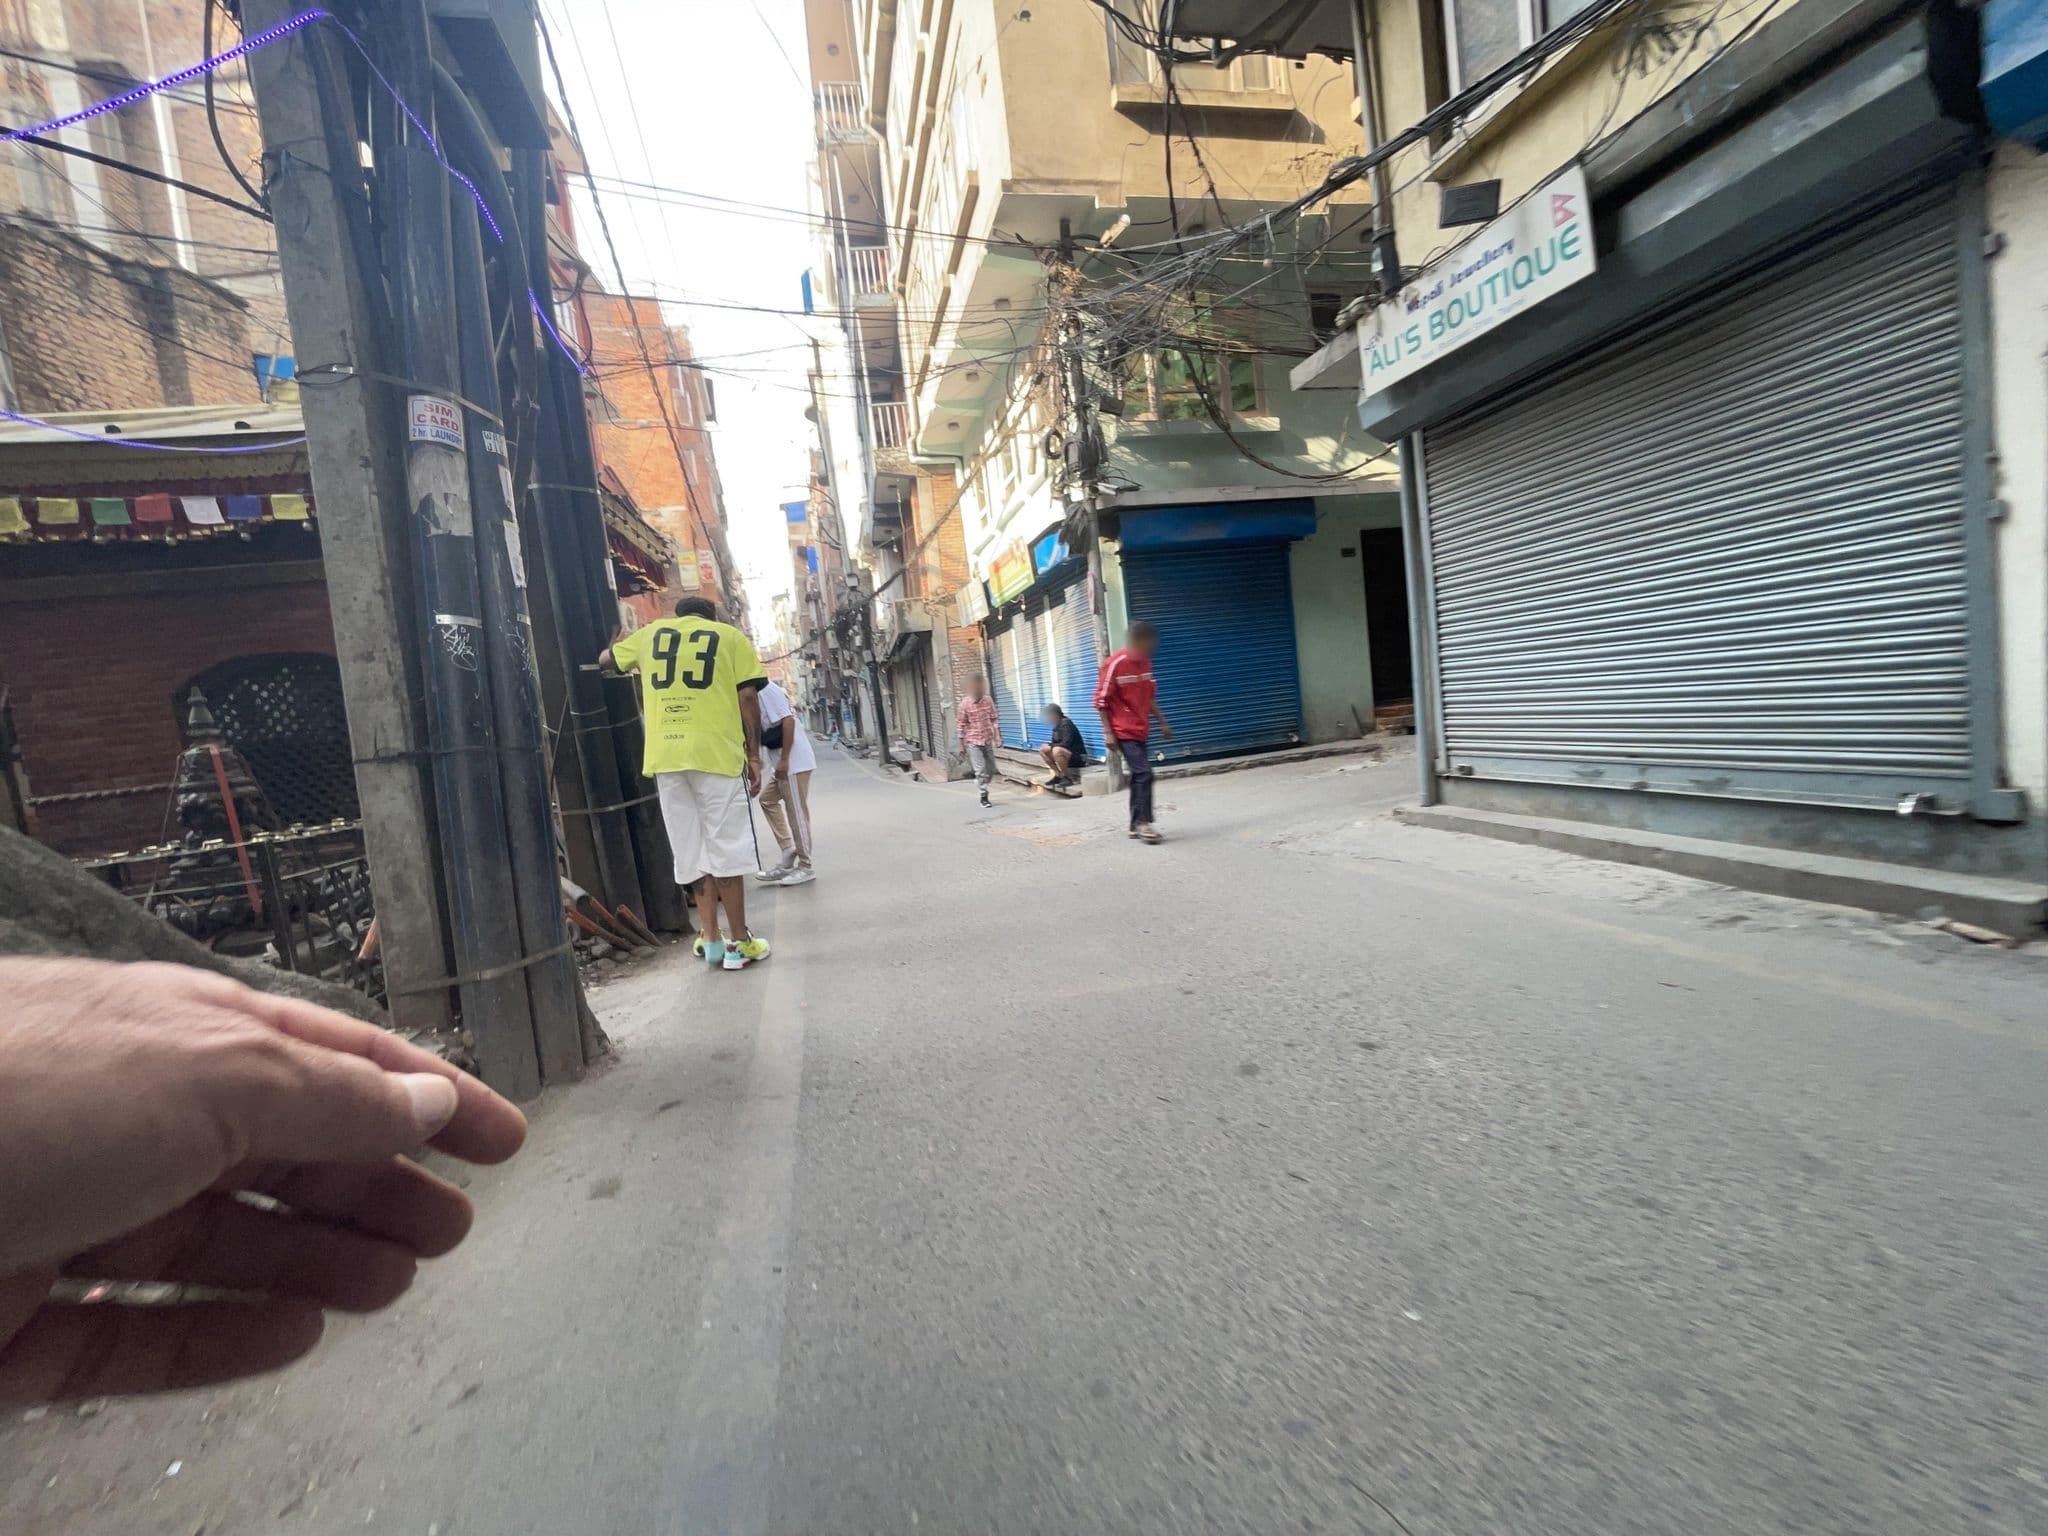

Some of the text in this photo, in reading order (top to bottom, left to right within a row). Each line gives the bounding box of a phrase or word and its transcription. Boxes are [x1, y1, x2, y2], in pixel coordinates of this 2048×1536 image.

[1450, 239, 1515, 286] Jewellery
[1369, 323, 1423, 377] ALI'S
[1429, 223, 1582, 340] BOUTIQUE
[416, 414, 459, 431] CARD
[424, 403, 453, 417] SIM
[651, 627, 720, 690] 93
